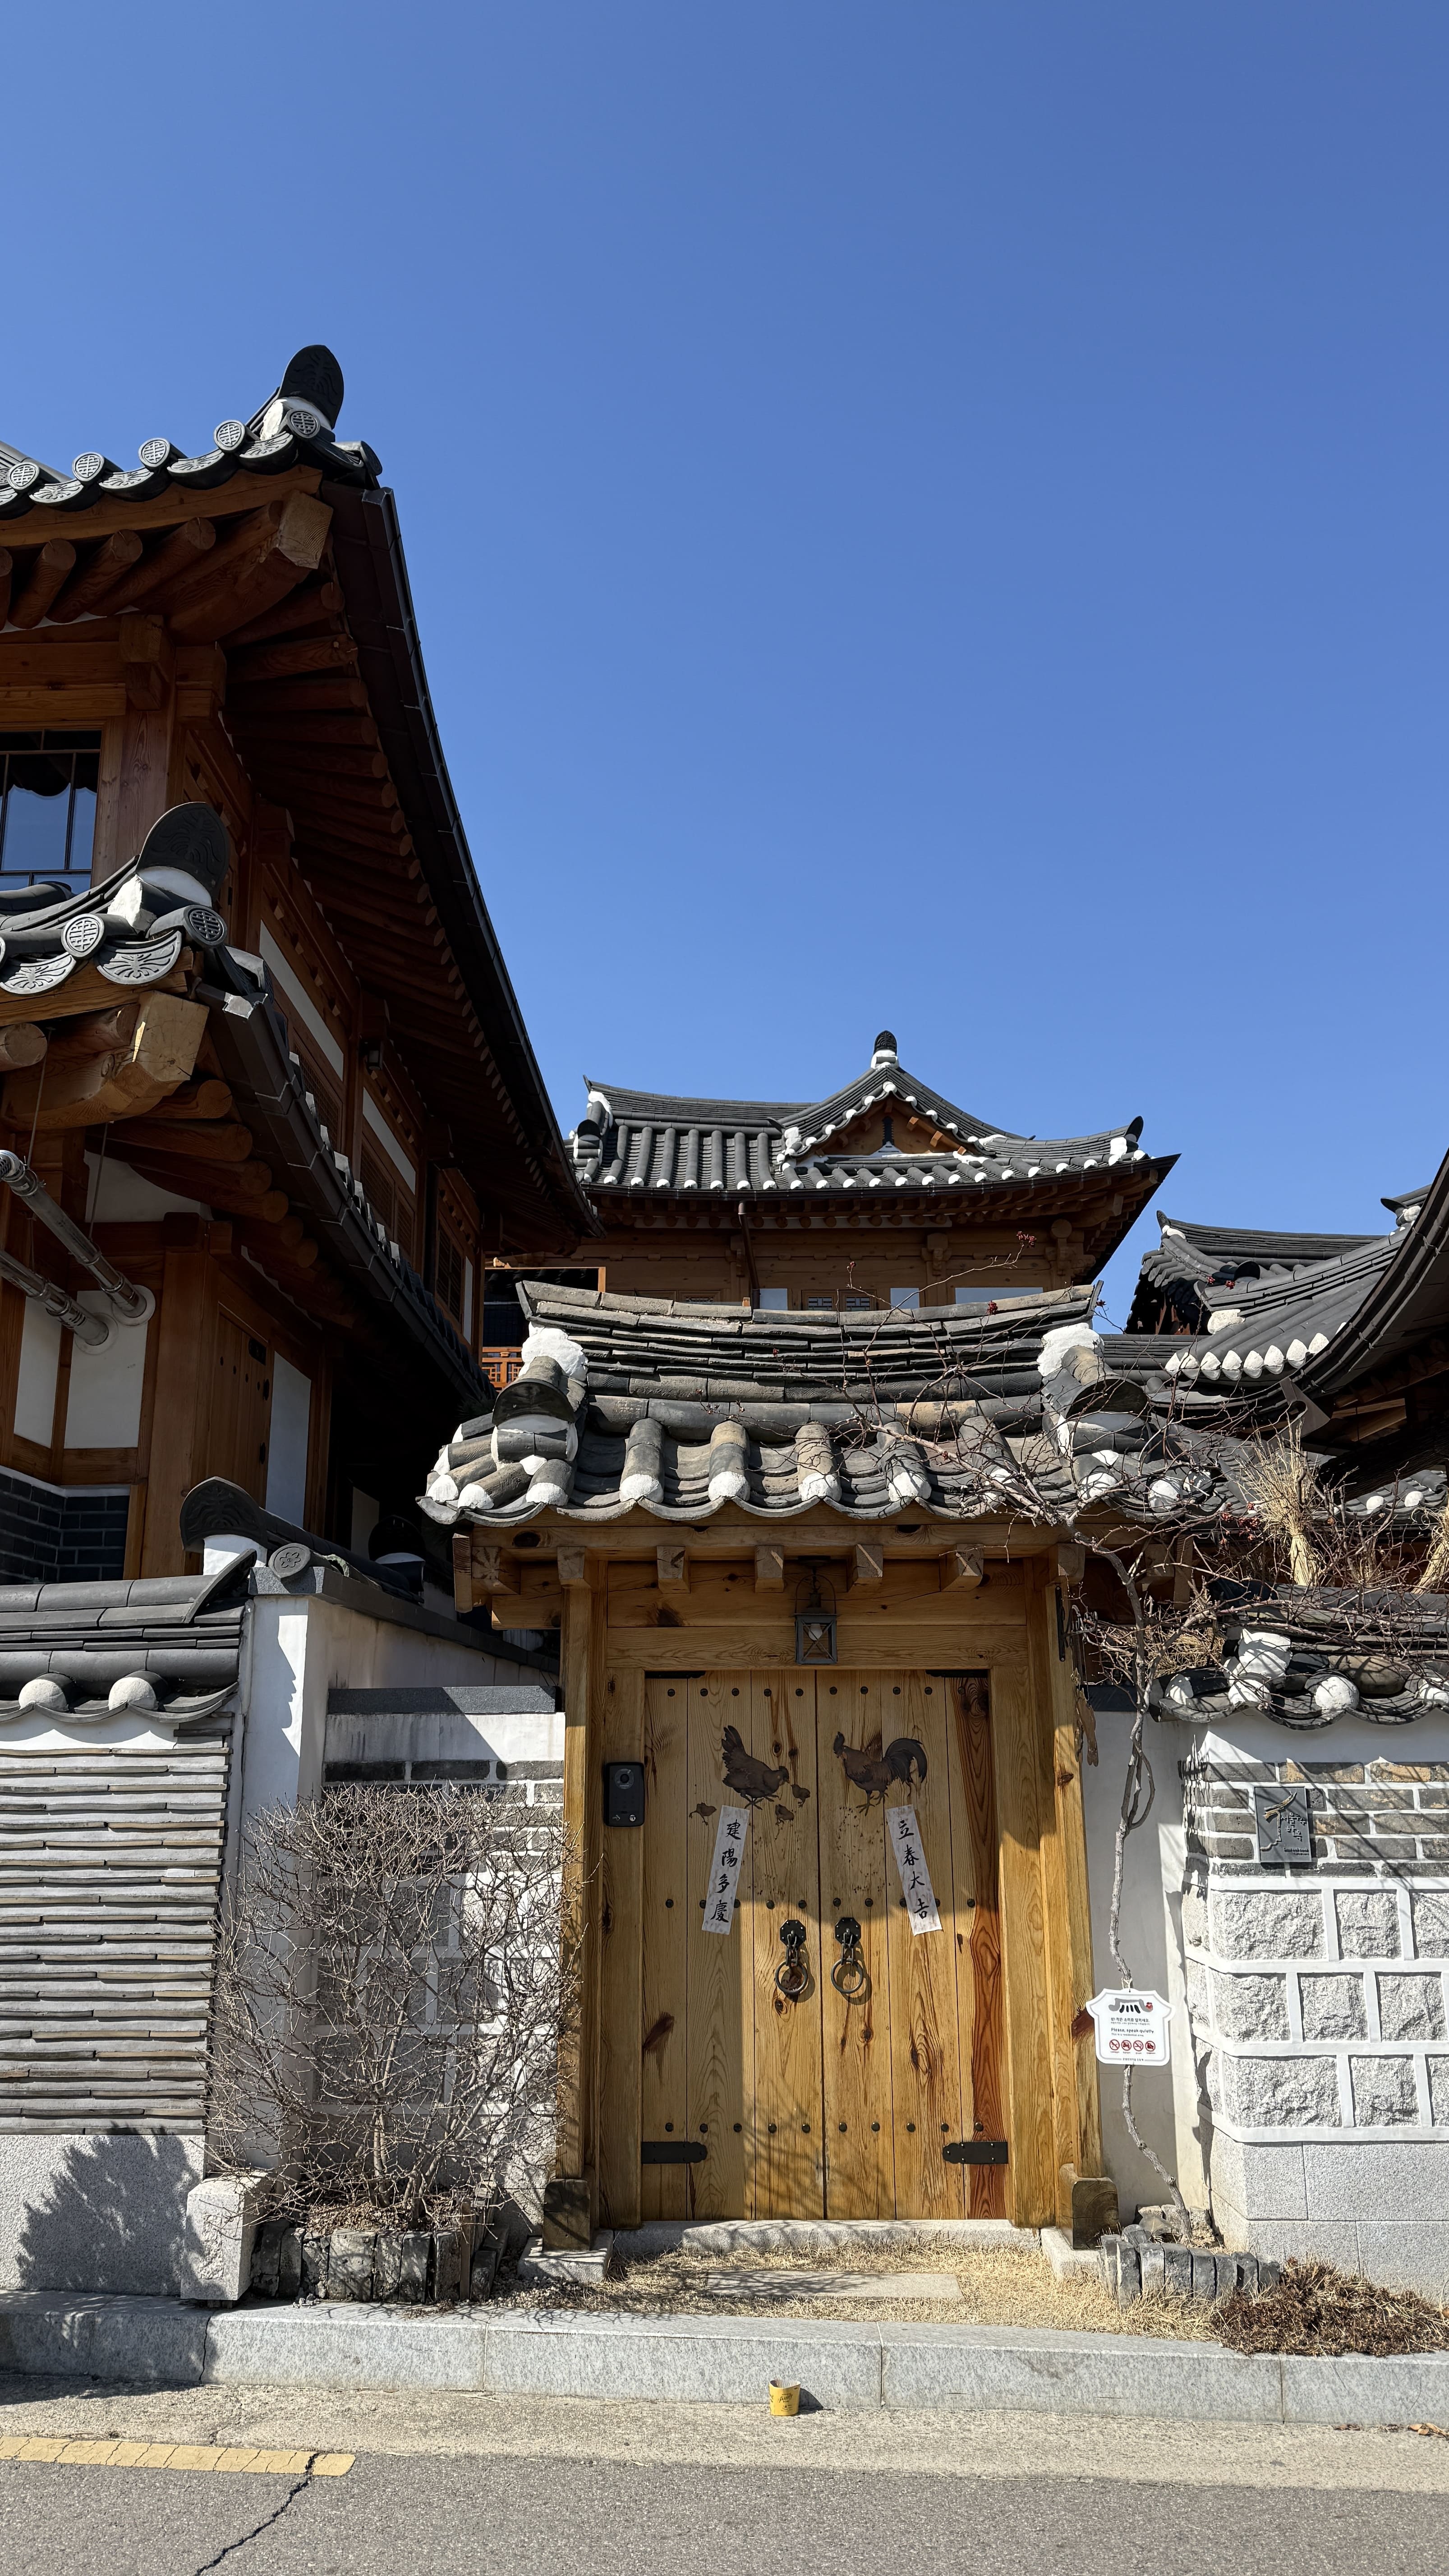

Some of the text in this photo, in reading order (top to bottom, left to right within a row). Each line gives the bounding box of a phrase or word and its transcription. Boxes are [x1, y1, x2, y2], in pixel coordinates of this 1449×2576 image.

[710, 1819, 741, 1923] 建陽多慶
[898, 1820, 930, 1920] 立春大吉
